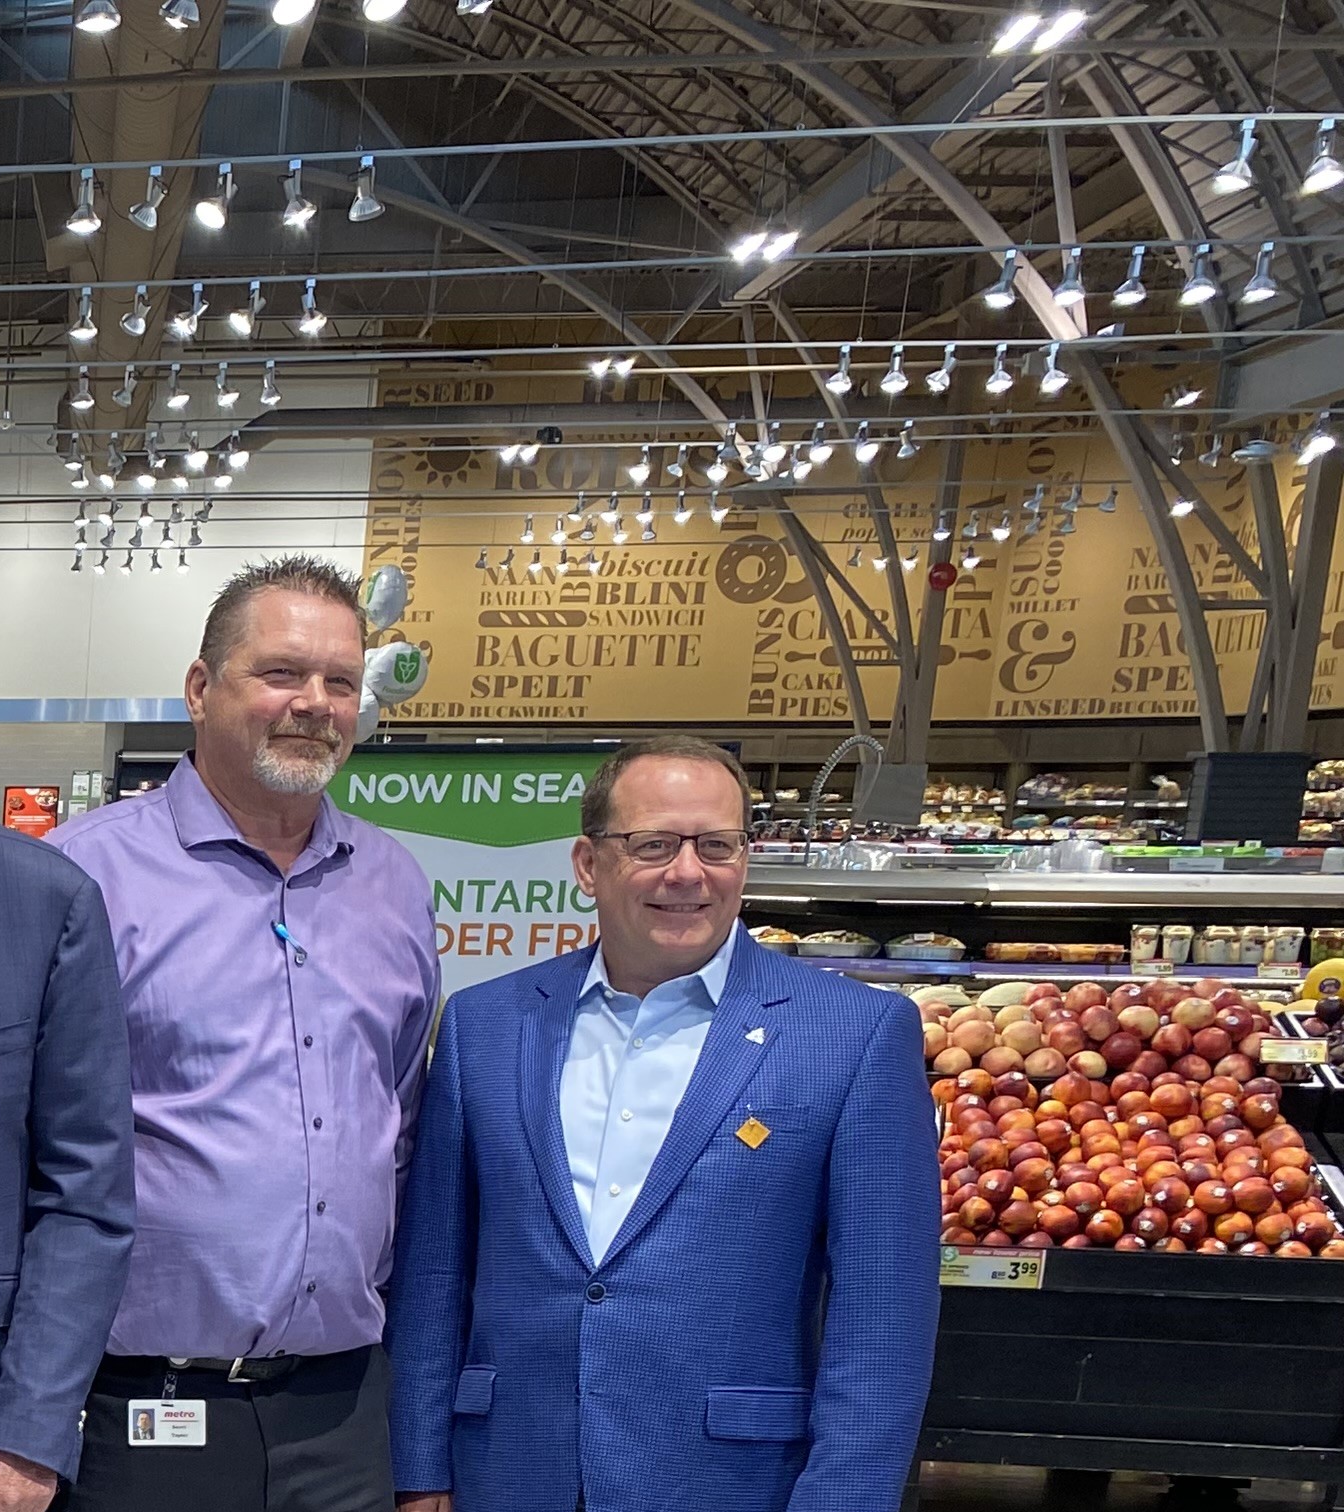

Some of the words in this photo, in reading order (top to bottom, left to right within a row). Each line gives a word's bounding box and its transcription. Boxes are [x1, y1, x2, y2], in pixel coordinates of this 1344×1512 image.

[841, 528, 906, 542] popy
[600, 550, 711, 577] biscuit
[479, 590, 557, 607] BARLEY
[595, 581, 707, 605] BLINI
[1008, 598, 1080, 614] MILLET
[587, 609, 705, 627] SANDWICH
[474, 634, 702, 668] BAGUETTE
[748, 606, 785, 717] BUNS
[1316, 657, 1338, 677] AKE
[470, 674, 592, 699] SPELT
[1311, 684, 1333, 705] IES
[469, 705, 588, 719] BUCKWHEAT
[778, 697, 850, 717] PIES
[994, 698, 1105, 717] LINSEED
[348, 773, 453, 804] NOW
[461, 773, 502, 804] IN
[511, 773, 586, 804] SEA
[434, 879, 597, 913] NTARIO
[438, 922, 513, 957] DER
